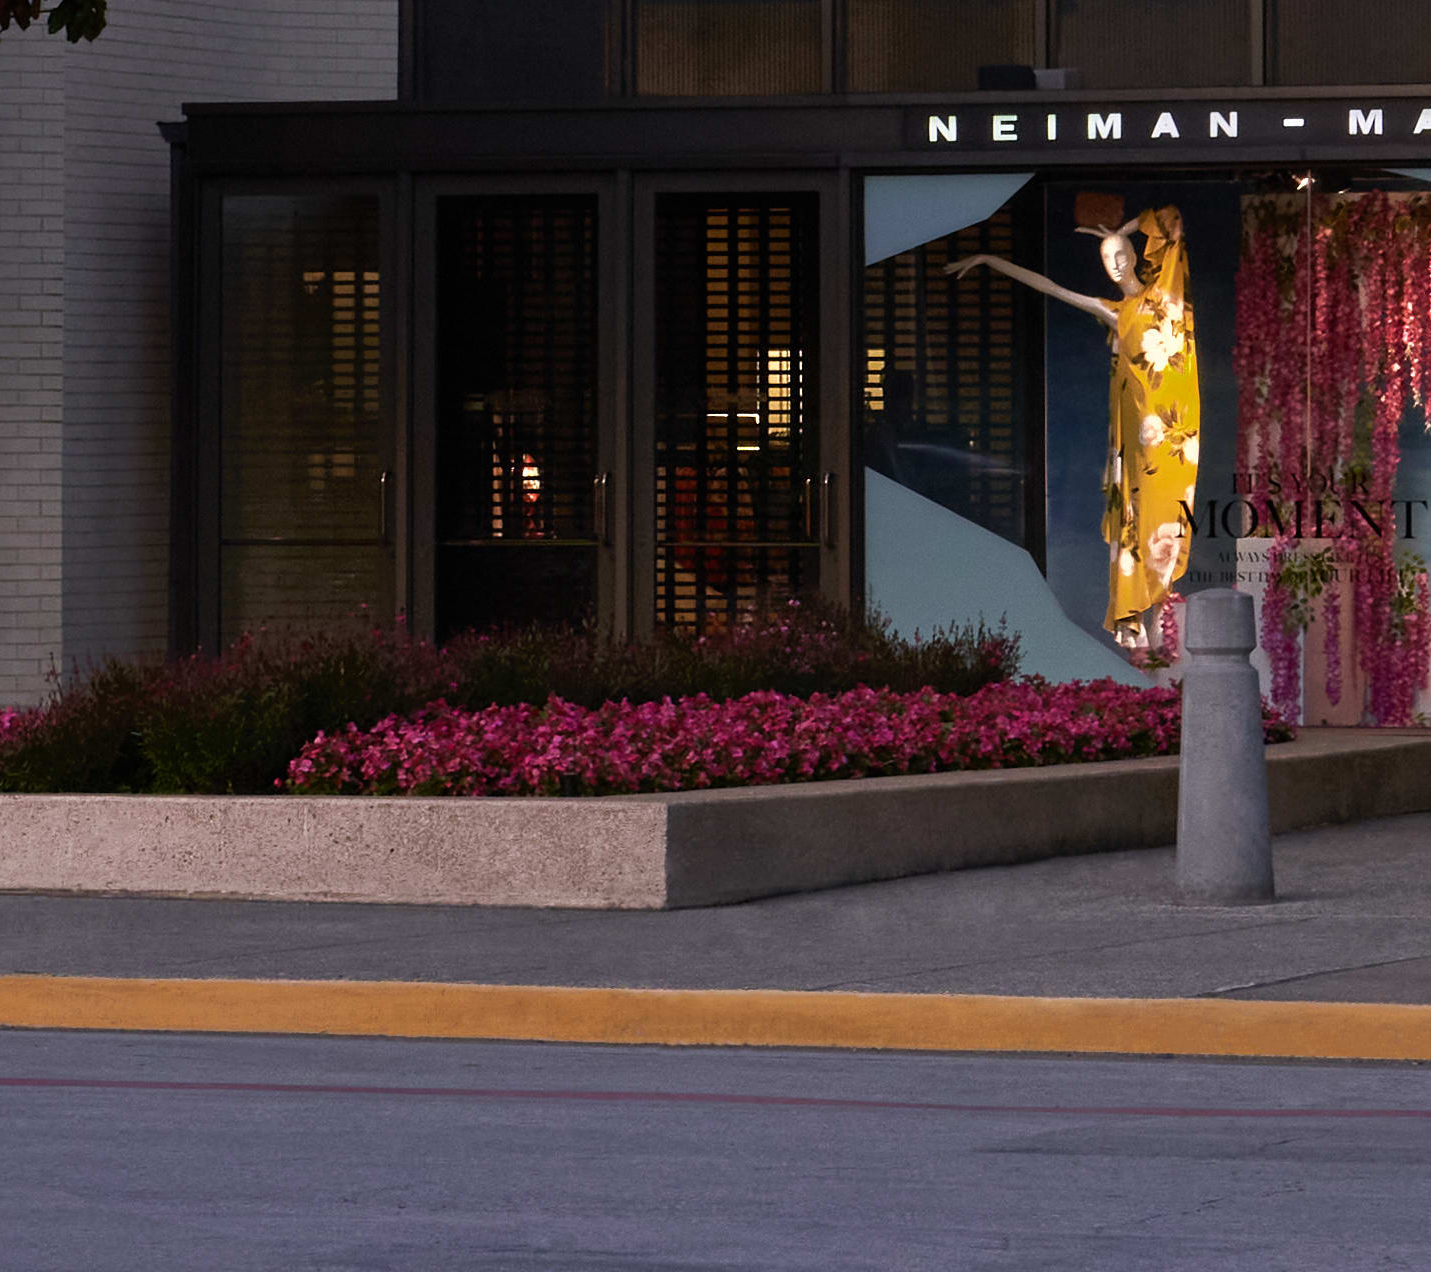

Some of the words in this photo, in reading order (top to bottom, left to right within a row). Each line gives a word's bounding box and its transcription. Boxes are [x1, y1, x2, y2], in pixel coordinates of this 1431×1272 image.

[927, 110, 1240, 143] NEIMAN
[1288, 471, 1370, 495] YOUR
[1176, 499, 1429, 539] MOMENT
[1218, 552, 1270, 564] ALWAYS
[1188, 571, 1215, 583] THE
[1219, 571, 1253, 583] BEST
